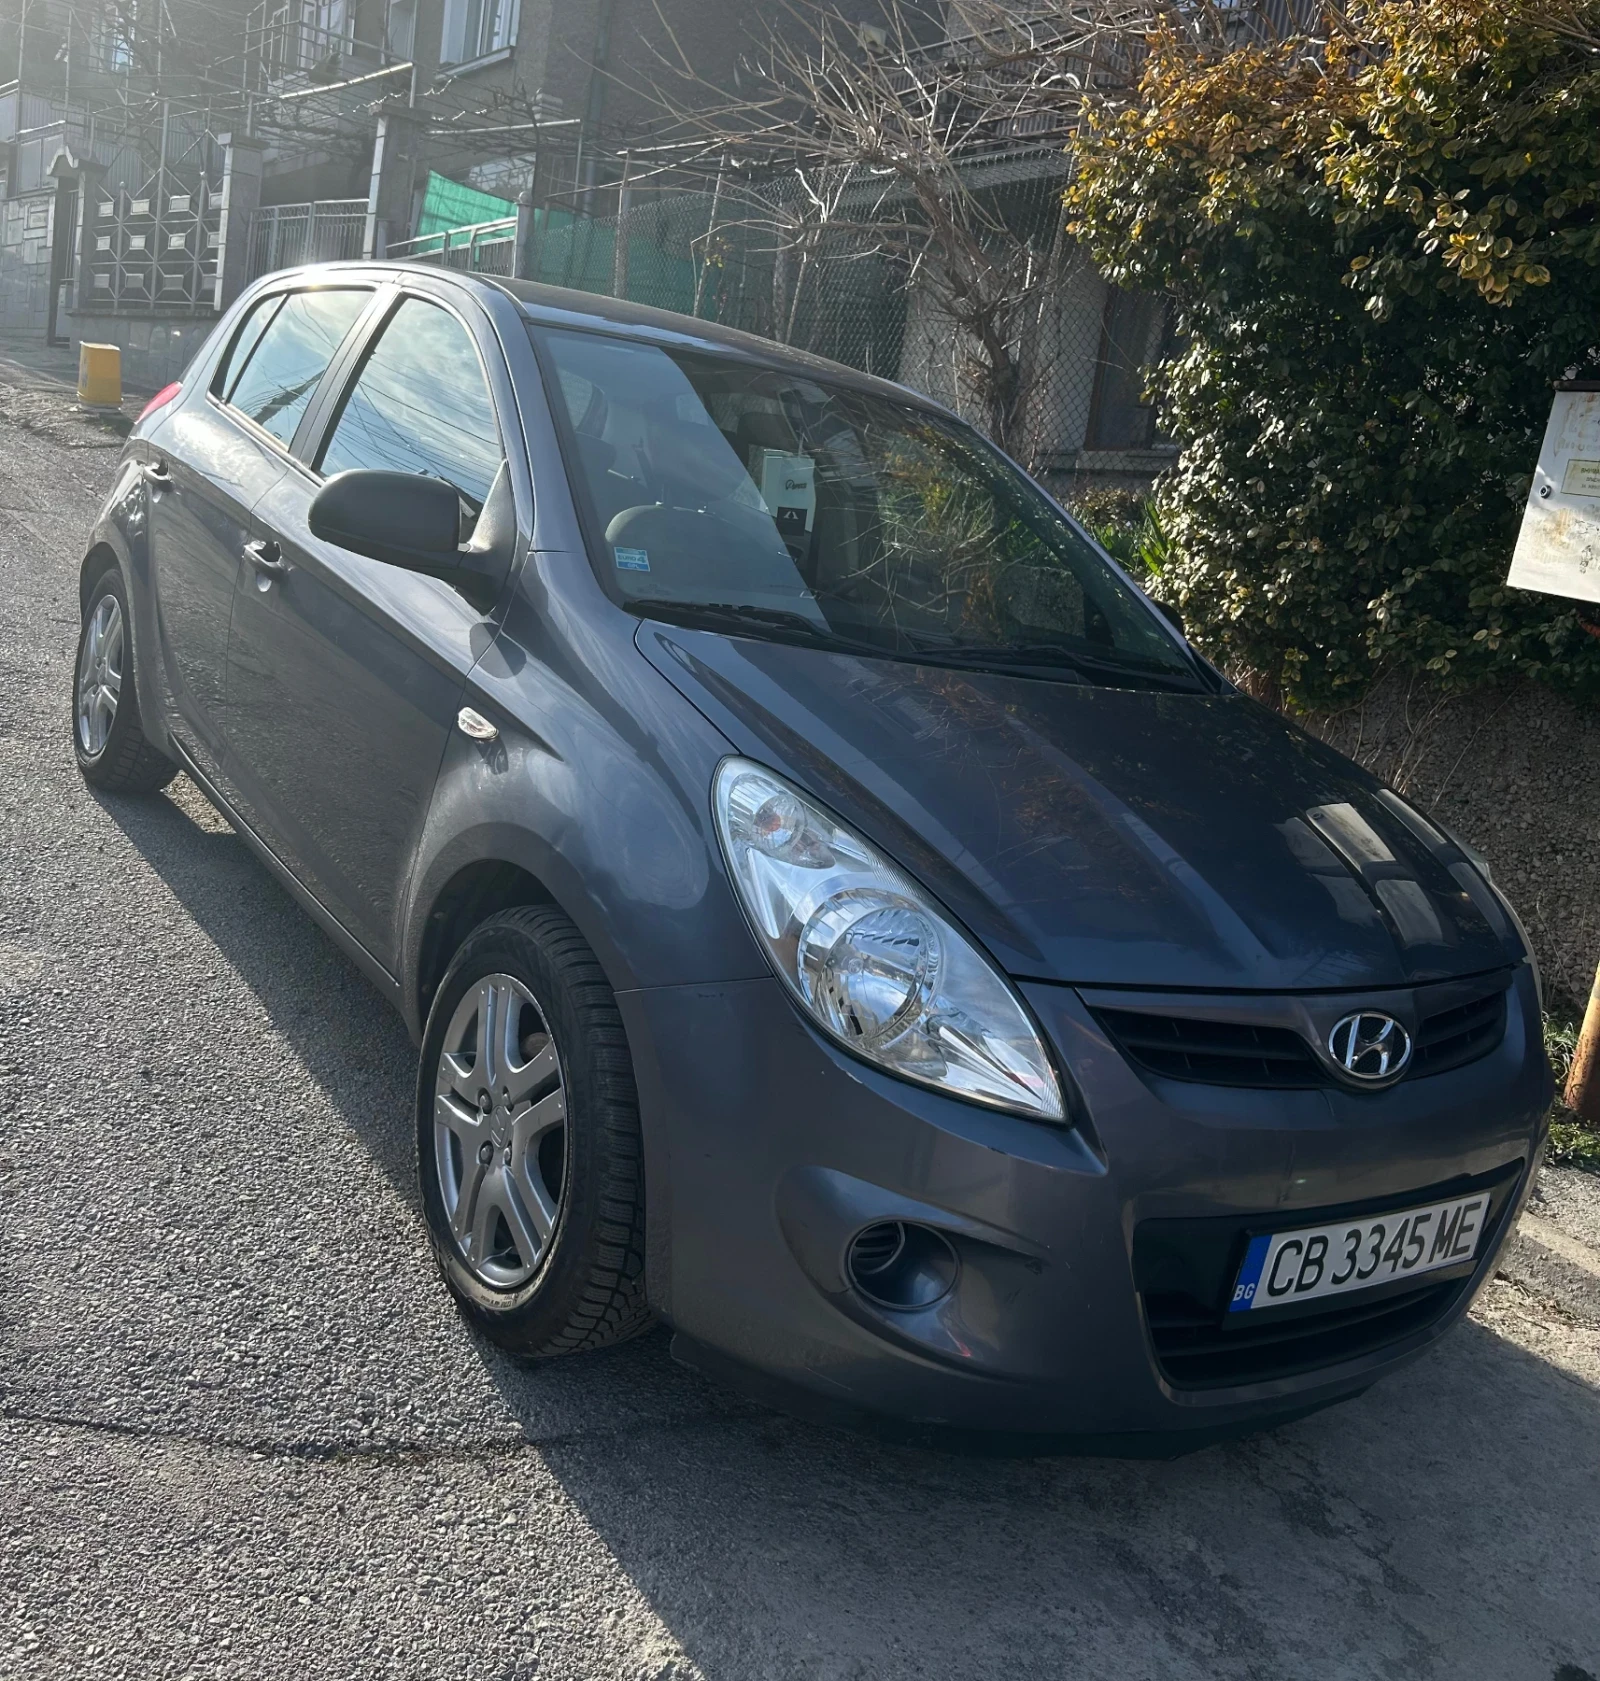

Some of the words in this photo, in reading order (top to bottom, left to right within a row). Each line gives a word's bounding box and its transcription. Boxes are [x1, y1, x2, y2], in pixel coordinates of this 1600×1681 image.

[1267, 1235, 1329, 1297] CB
[1330, 1213, 1432, 1285] 3345
[1427, 1201, 1482, 1264] ME
[1234, 1283, 1255, 1301] BG
